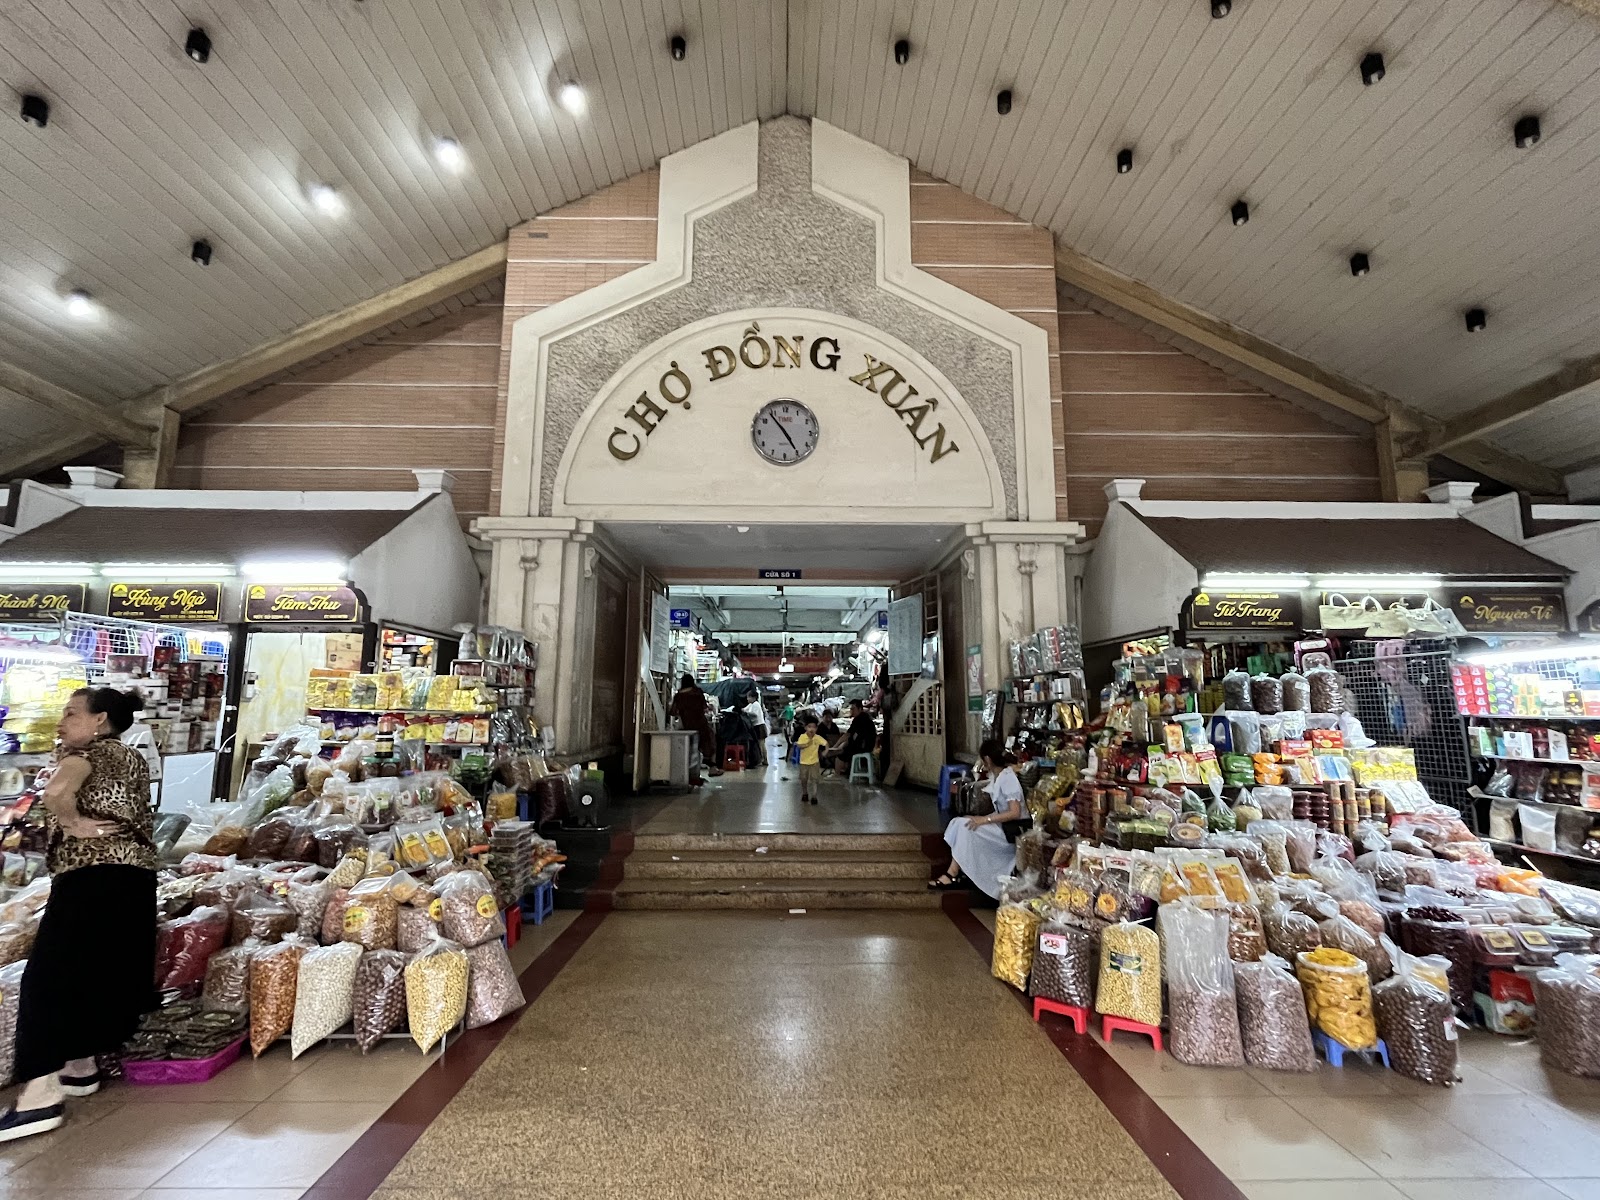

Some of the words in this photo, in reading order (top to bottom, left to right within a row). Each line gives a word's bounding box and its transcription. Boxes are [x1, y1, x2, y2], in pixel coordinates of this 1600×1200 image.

[608, 360, 692, 460] CHỢ
[701, 321, 841, 382] ĐỒNG
[849, 353, 960, 464] XUÂN
[122, 588, 169, 611] Hùng
[170, 589, 207, 611] Ngà
[1235, 601, 1282, 622] Trang
